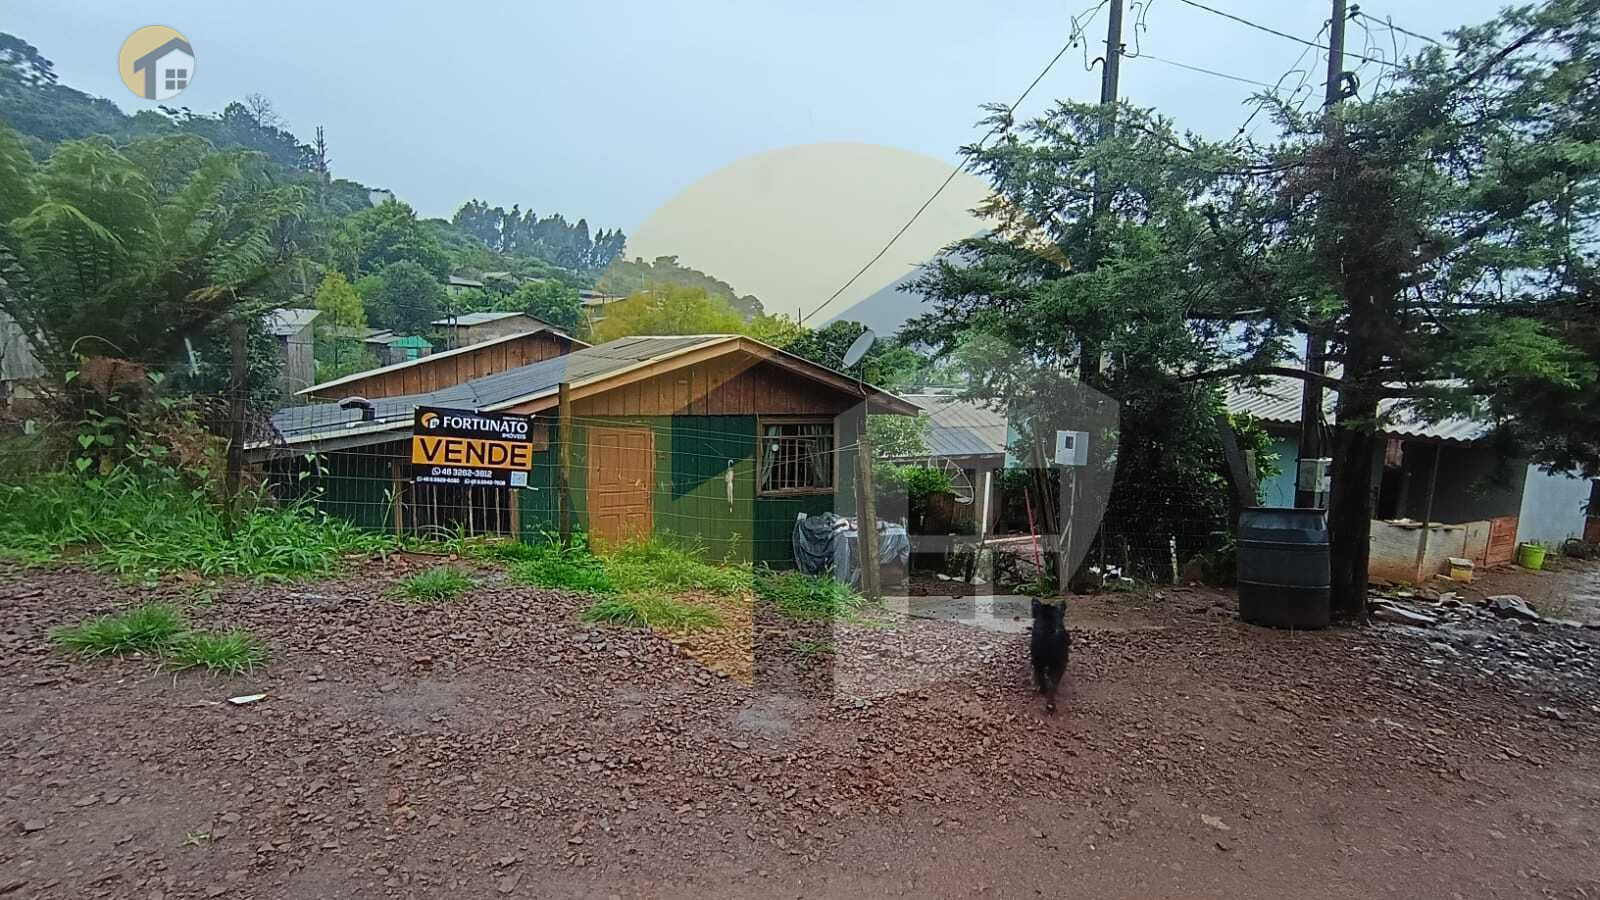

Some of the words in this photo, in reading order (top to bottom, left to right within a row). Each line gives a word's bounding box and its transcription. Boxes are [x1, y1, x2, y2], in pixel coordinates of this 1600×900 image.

[443, 415, 528, 434] FORTUNATO
[419, 437, 529, 467] VENDE
[441, 467, 452, 476] 48
